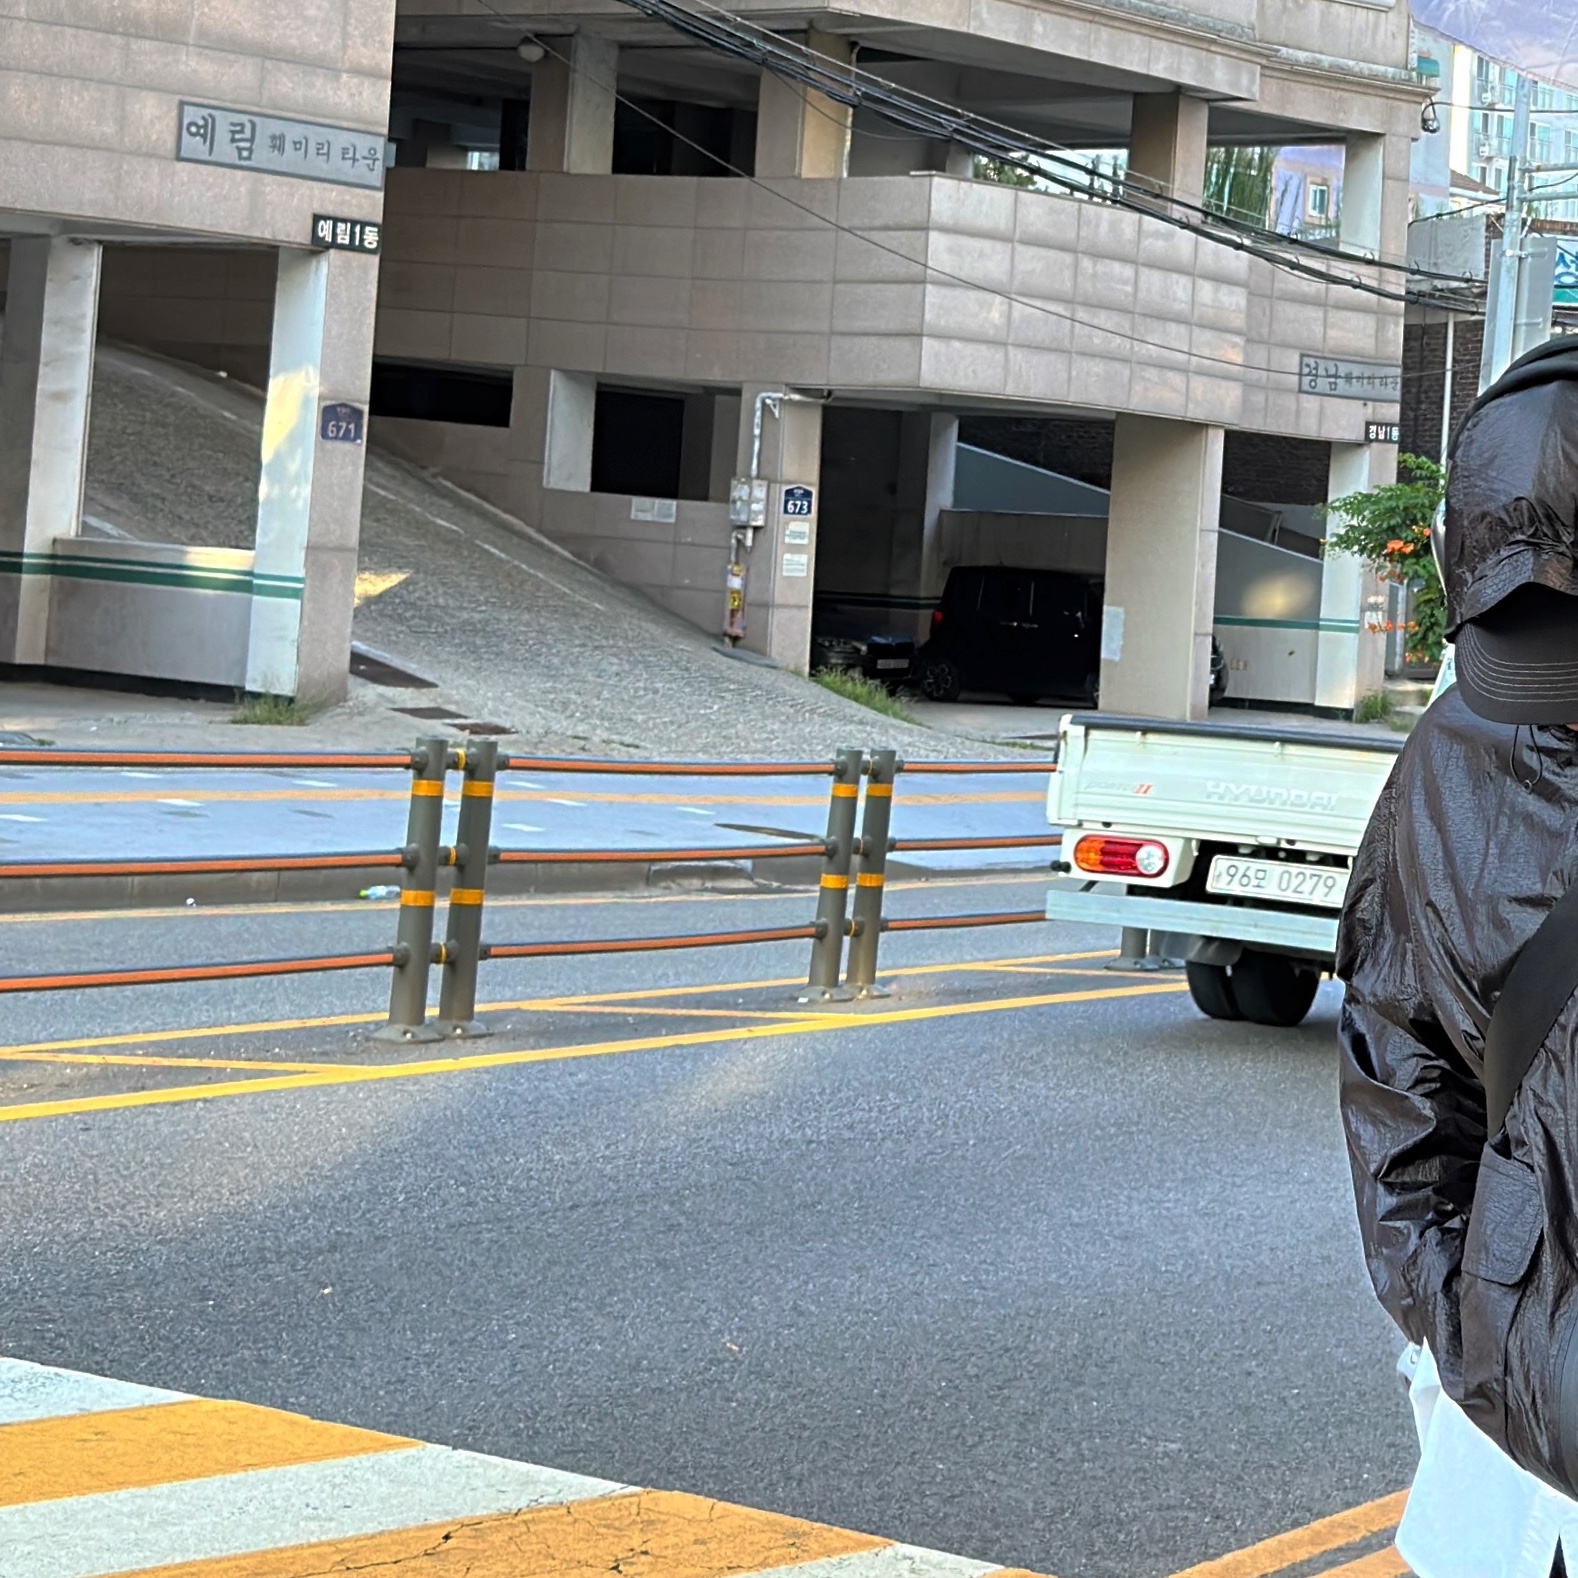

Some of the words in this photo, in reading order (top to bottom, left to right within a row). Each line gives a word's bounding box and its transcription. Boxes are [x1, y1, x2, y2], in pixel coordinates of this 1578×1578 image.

[186, 112, 257, 162] 예림
[317, 219, 380, 249] 예림1동
[1304, 360, 1343, 391] 경남
[327, 420, 356, 439] 671
[787, 500, 809, 514] 673
[1205, 780, 1340, 811] HYUNDAI
[1277, 869, 1337, 898] 0279
